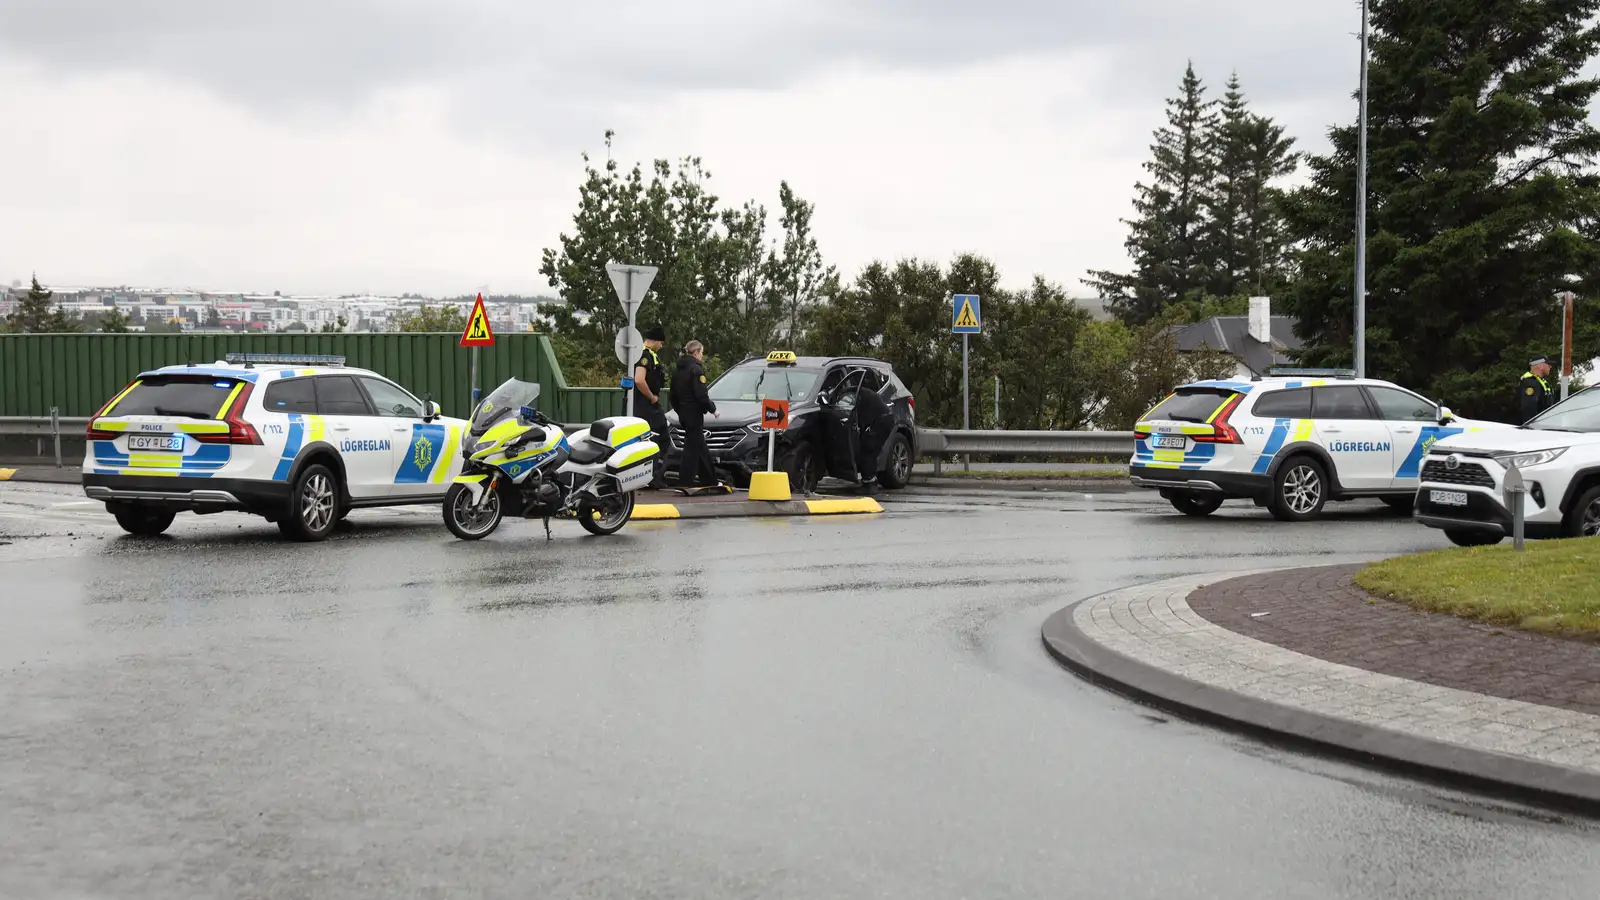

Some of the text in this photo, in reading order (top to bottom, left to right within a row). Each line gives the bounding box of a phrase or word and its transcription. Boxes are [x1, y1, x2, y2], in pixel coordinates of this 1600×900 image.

[769, 352, 792, 360] TAXI
[269, 424, 284, 434] 112
[1250, 427, 1265, 435] 112
[136, 437, 152, 447] GY
[159, 438, 180, 449] L28
[340, 437, 391, 452] LÖGREGLAN
[1329, 439, 1391, 452] LÖGREGLAN
[621, 468, 652, 484] LÖGREGLAN
